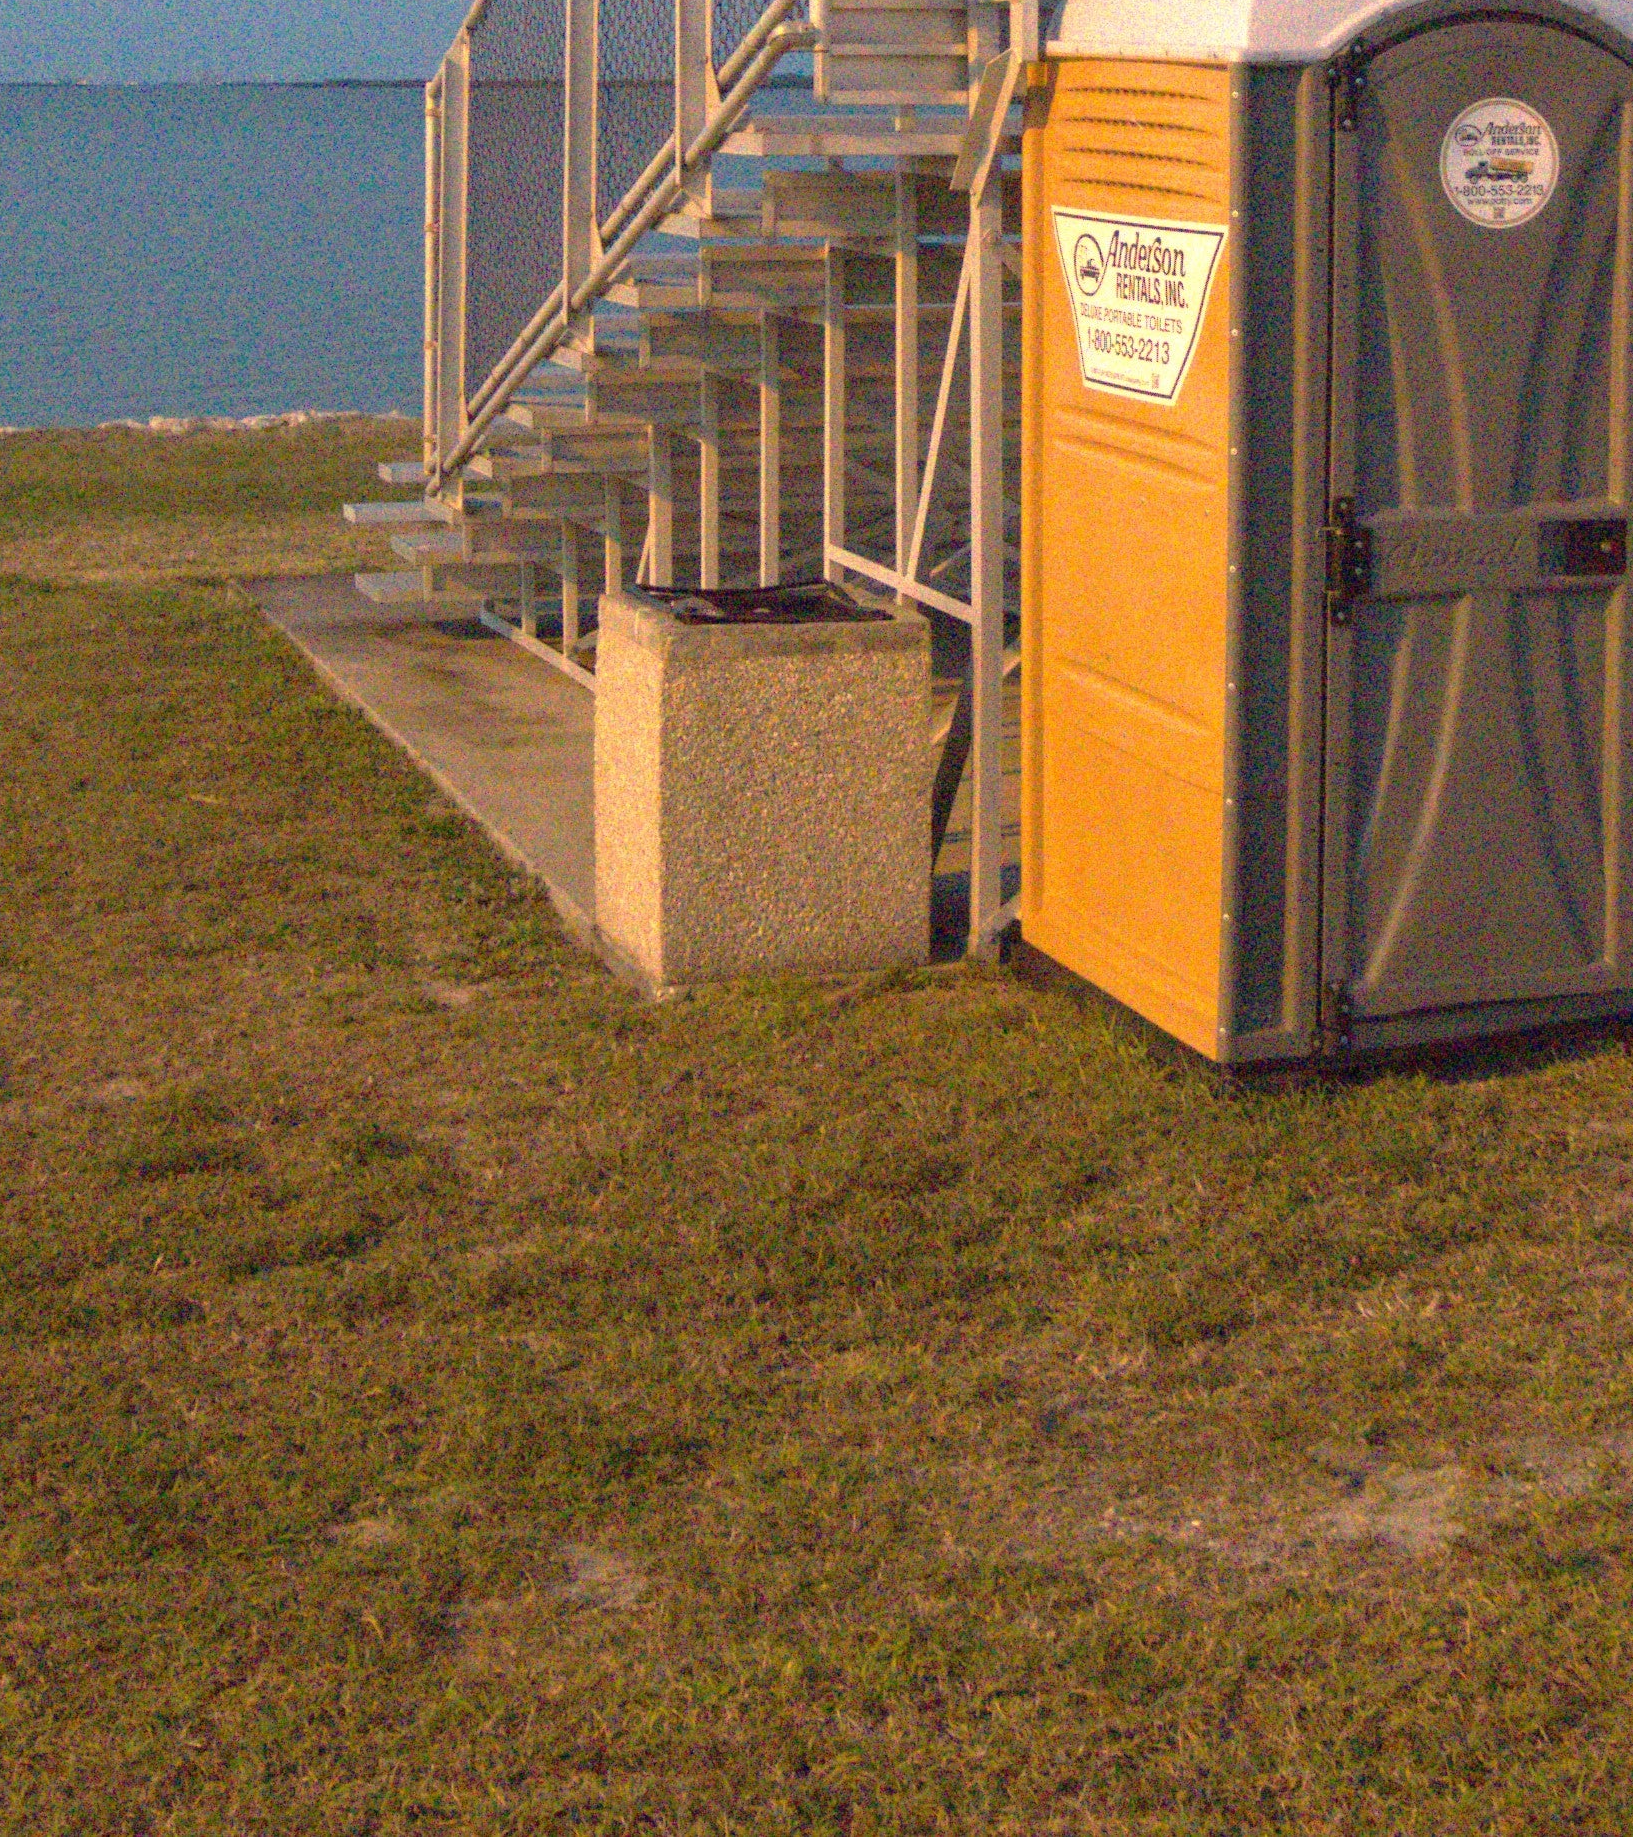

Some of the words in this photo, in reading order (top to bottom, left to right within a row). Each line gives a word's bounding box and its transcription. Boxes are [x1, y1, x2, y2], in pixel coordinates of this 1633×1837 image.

[1483, 120, 1541, 135] Anderson
[1505, 148, 1539, 156] SERVICE
[1454, 184, 1544, 197] 1-800-553-2213
[1105, 230, 1187, 277] Anderson
[1165, 279, 1189, 309] INC.
[1104, 307, 1142, 329] PORTABLE
[1144, 315, 1183, 334] TOILETS
[1087, 326, 1170, 365] 1-800-553-2213
